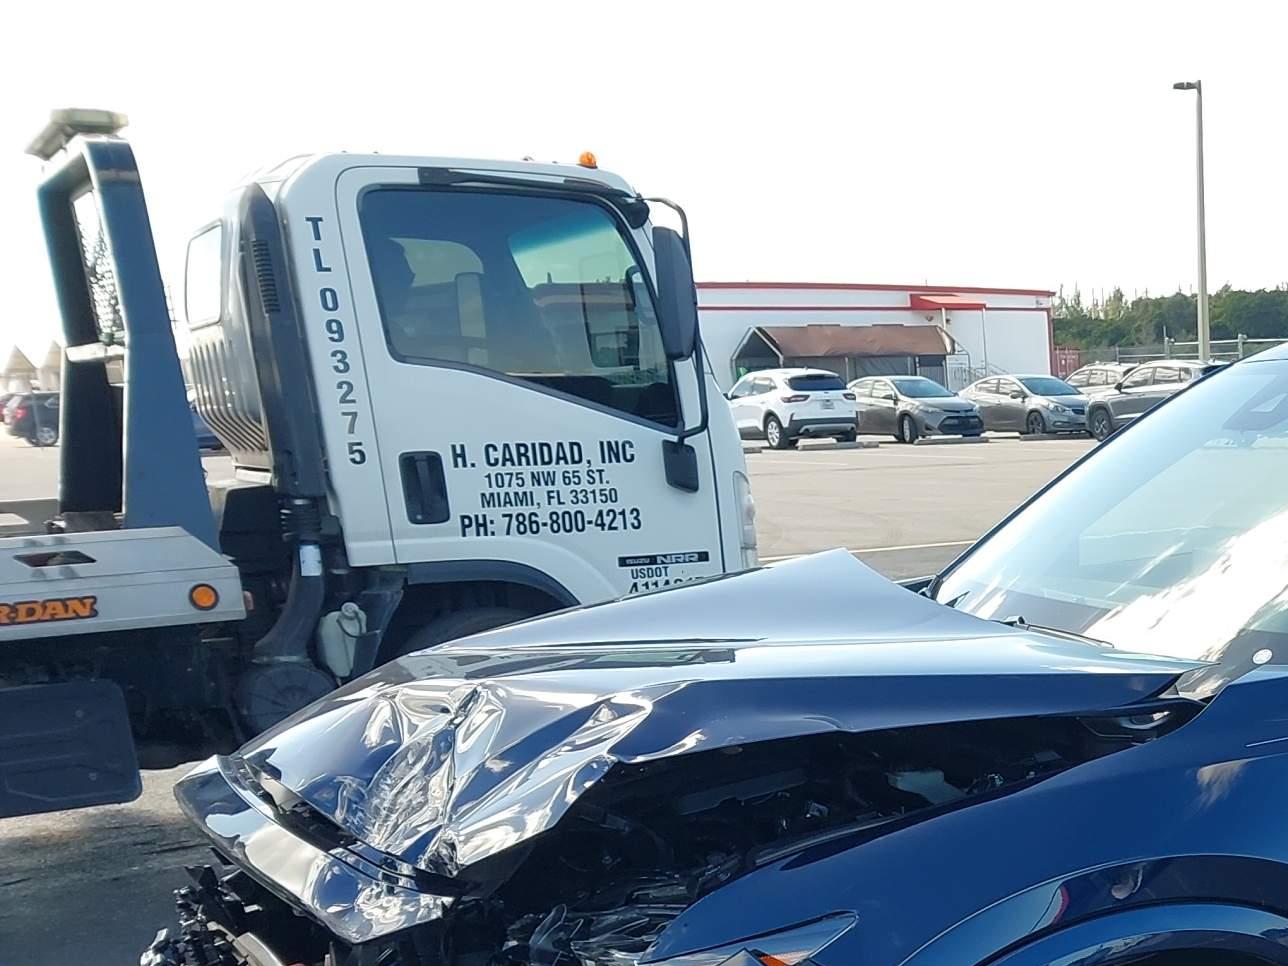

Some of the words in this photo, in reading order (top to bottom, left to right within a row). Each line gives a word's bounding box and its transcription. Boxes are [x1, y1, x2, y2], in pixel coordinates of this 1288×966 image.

[450, 444, 477, 468] H.
[484, 441, 593, 468] CARIDAD,
[599, 440, 636, 464] INC
[484, 472, 526, 489] 1075
[531, 470, 557, 487] NW
[562, 469, 582, 486] 65
[586, 469, 610, 486] ST.
[480, 491, 542, 509] MIAMI,
[546, 489, 566, 506] FL
[570, 487, 619, 505] 33150
[459, 514, 496, 538] PH:
[501, 507, 643, 536] 786-800-4213
[656, 553, 699, 564] NRR
[630, 565, 670, 580] USDOT
